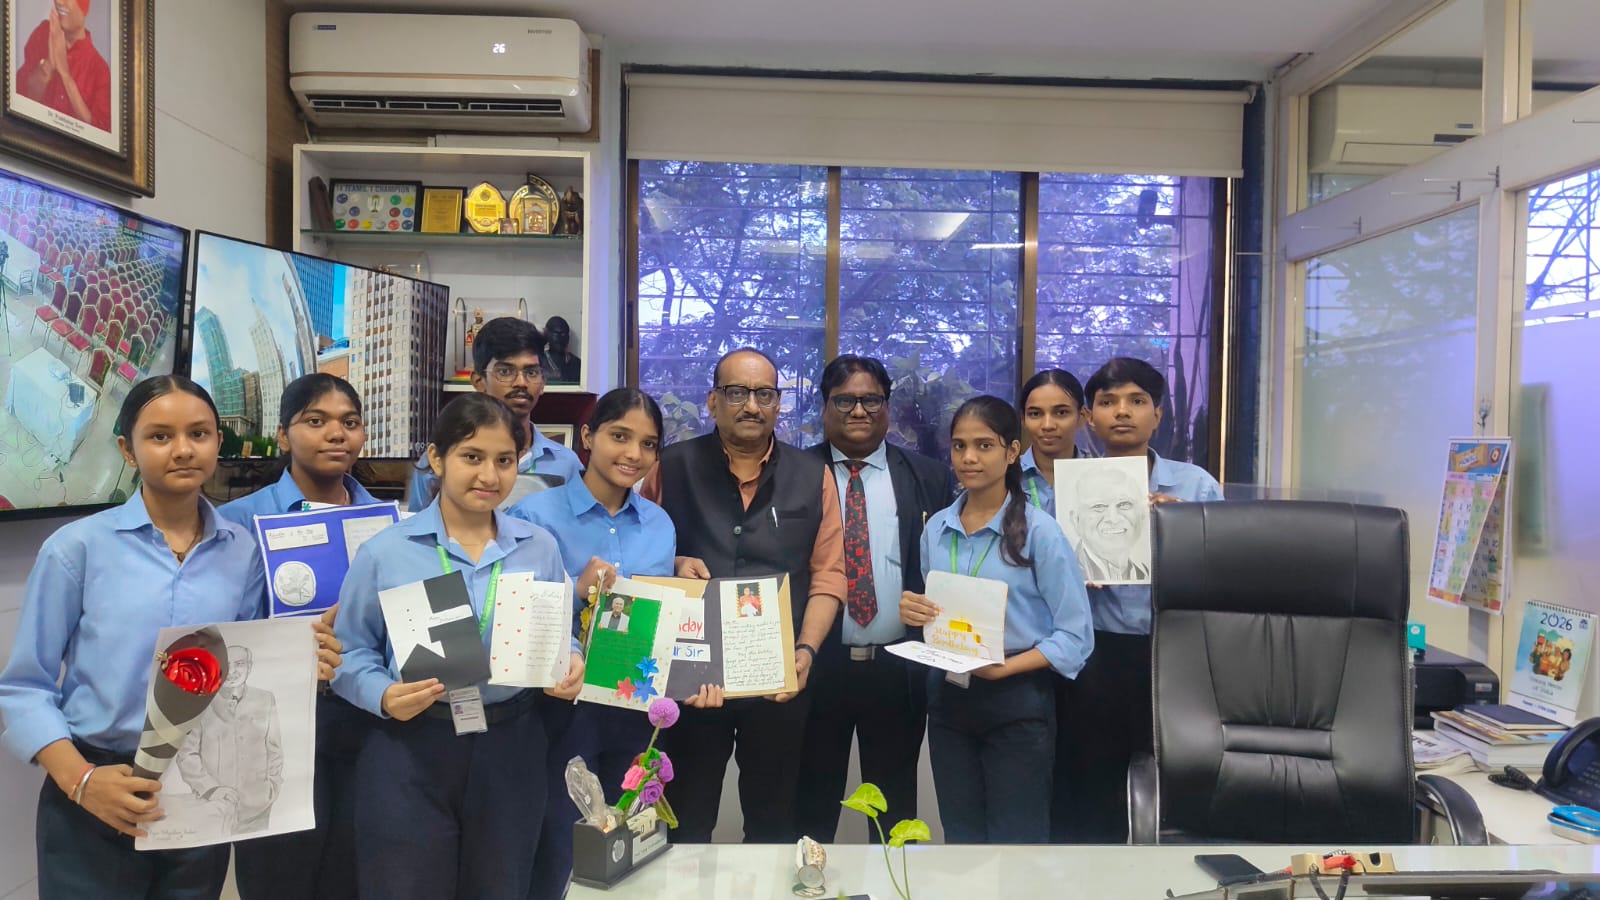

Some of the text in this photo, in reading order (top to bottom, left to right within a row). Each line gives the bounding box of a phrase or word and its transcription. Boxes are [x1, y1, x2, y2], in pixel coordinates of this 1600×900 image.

[492, 43, 506, 54] 26
[1540, 612, 1573, 631] 2026
[934, 627, 967, 641] Happy
[685, 645, 704, 658] Sir
